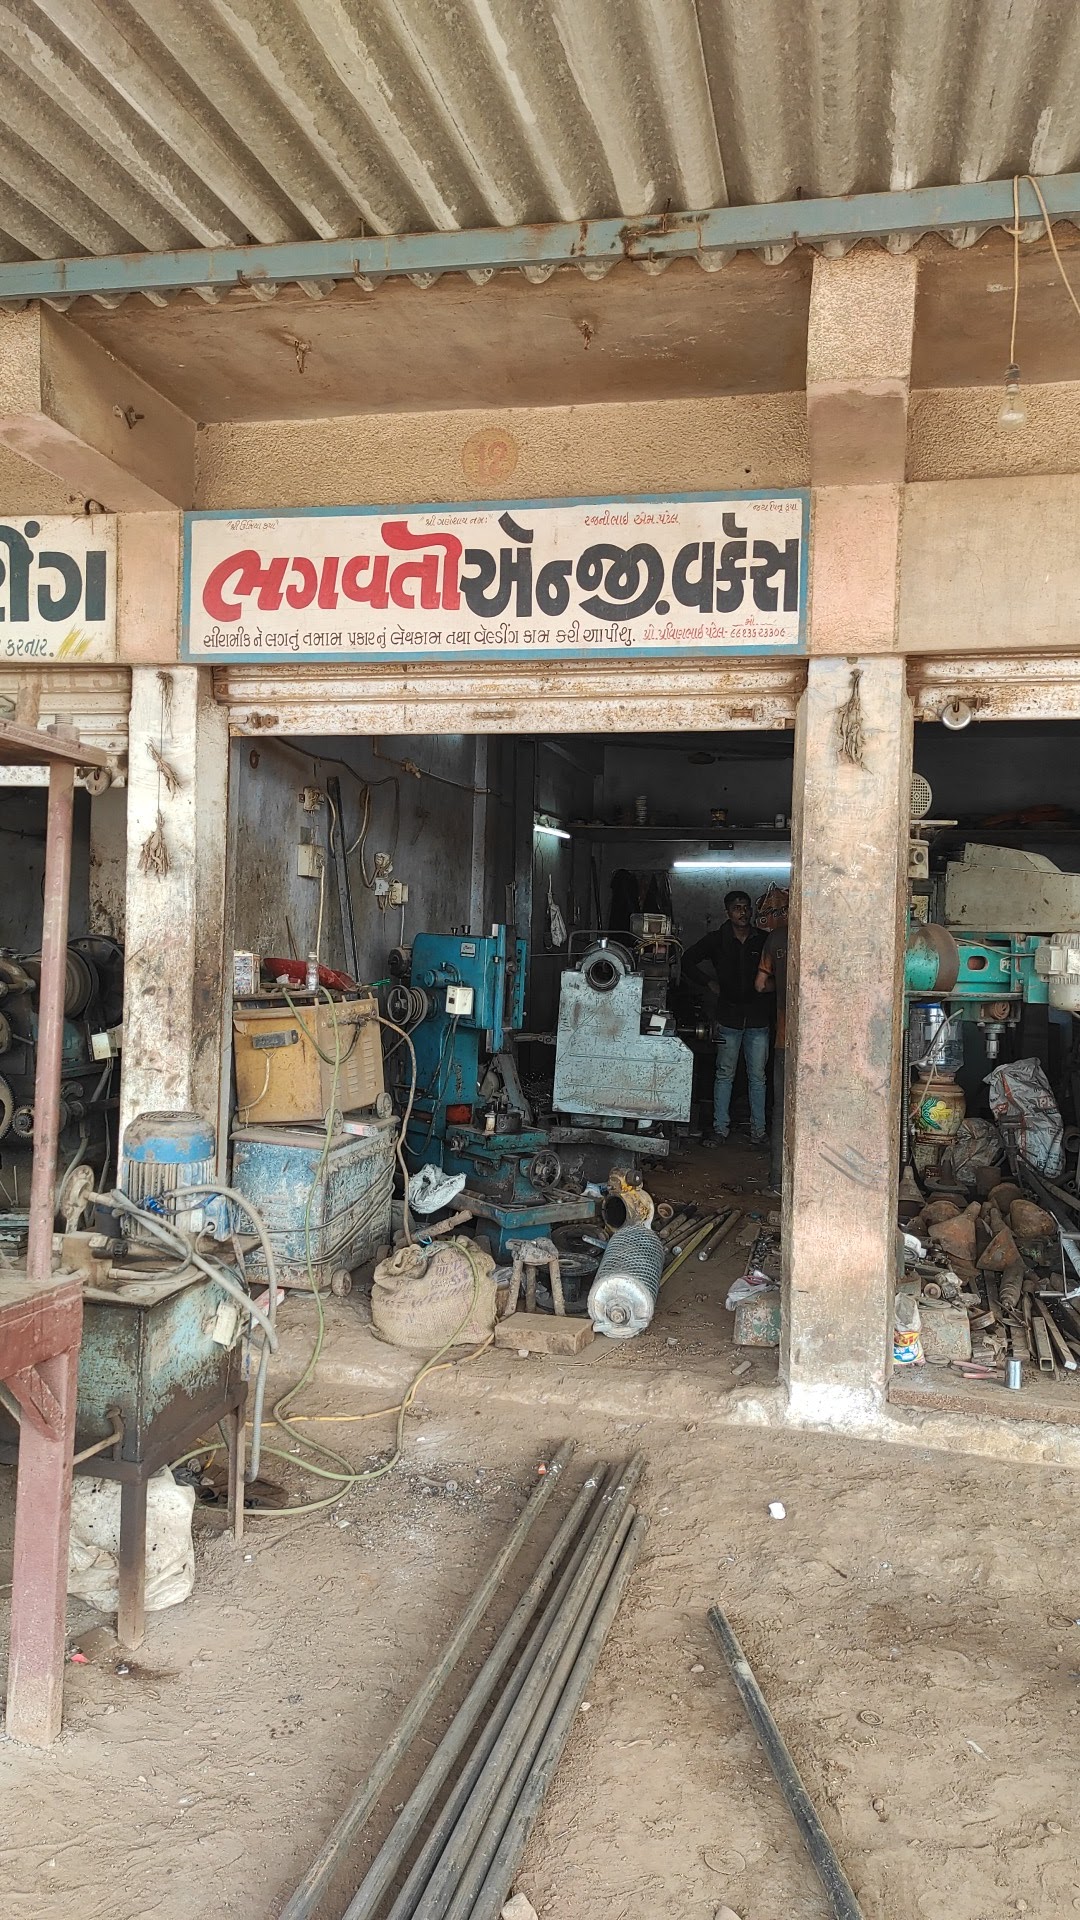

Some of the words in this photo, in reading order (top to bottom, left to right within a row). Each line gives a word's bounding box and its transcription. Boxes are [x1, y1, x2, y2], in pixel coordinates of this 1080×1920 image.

[202, 520, 463, 623] ભગવતી
[265, 629, 300, 651] લગતું
[302, 632, 343, 646] તમામ
[446, 631, 471, 645] તથા
[523, 629, 551, 644] કામ
[555, 620, 580, 643] કરી
